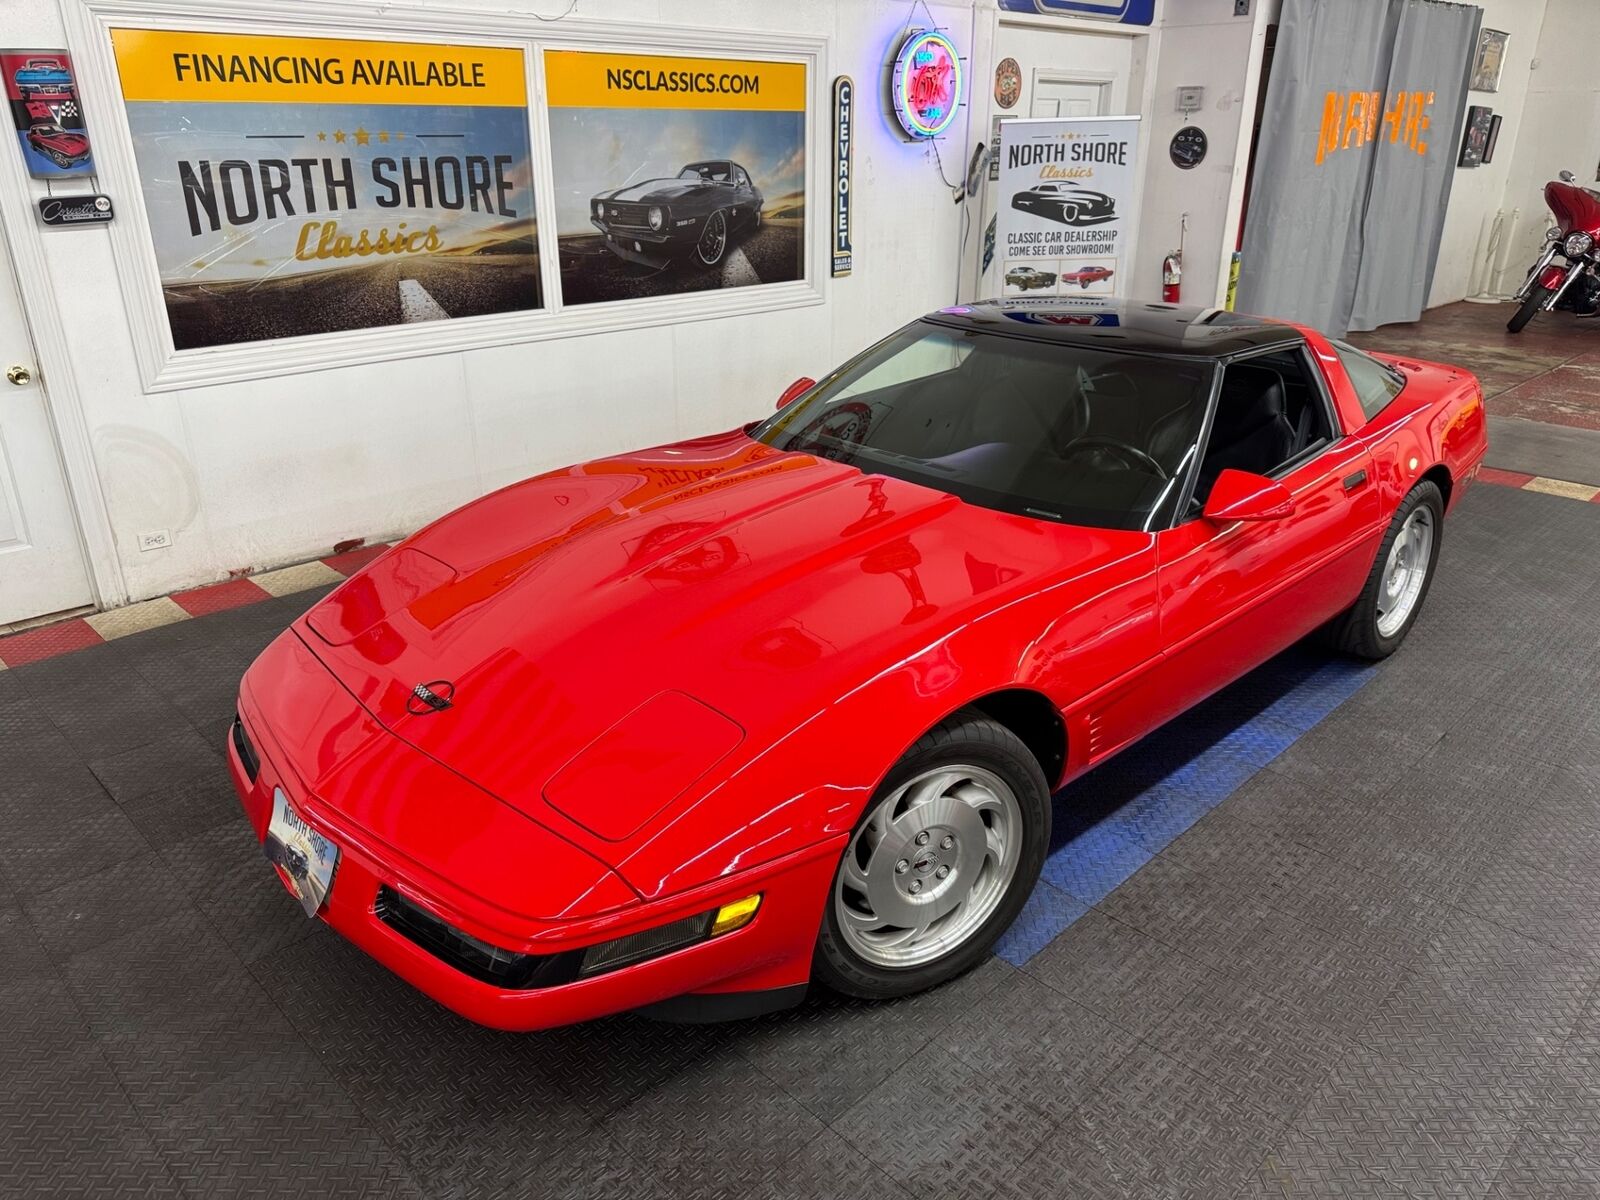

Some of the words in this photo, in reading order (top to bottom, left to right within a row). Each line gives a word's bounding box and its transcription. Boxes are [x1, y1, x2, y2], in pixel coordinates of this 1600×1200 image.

[173, 53, 345, 85] FINANCING
[351, 59, 486, 88] AVAILABLE
[606, 68, 760, 95] NSCLASSICS.COM
[1177, 135, 1203, 143] GTO
[838, 86, 850, 248] CHEVROLET
[1008, 143, 1066, 170] NORTH
[1070, 141, 1128, 166] SHORE
[1038, 164, 1095, 179] Classics
[177, 156, 358, 238] NORTH
[371, 154, 517, 219] SHORE
[42, 201, 97, 221] Corvette
[295, 220, 445, 262] Classics
[1007, 232, 1043, 245] CLASSIC
[1044, 231, 1062, 244] CAR
[1064, 230, 1118, 243] DEALERSHIP
[1008, 246, 1031, 257] COME
[1032, 245, 1047, 256] SEE
[1048, 245, 1065, 256] OUR
[1065, 243, 1114, 255] SHOWROOM!
[283, 804, 307, 838] NORTH
[307, 828, 329, 865] SHORE
